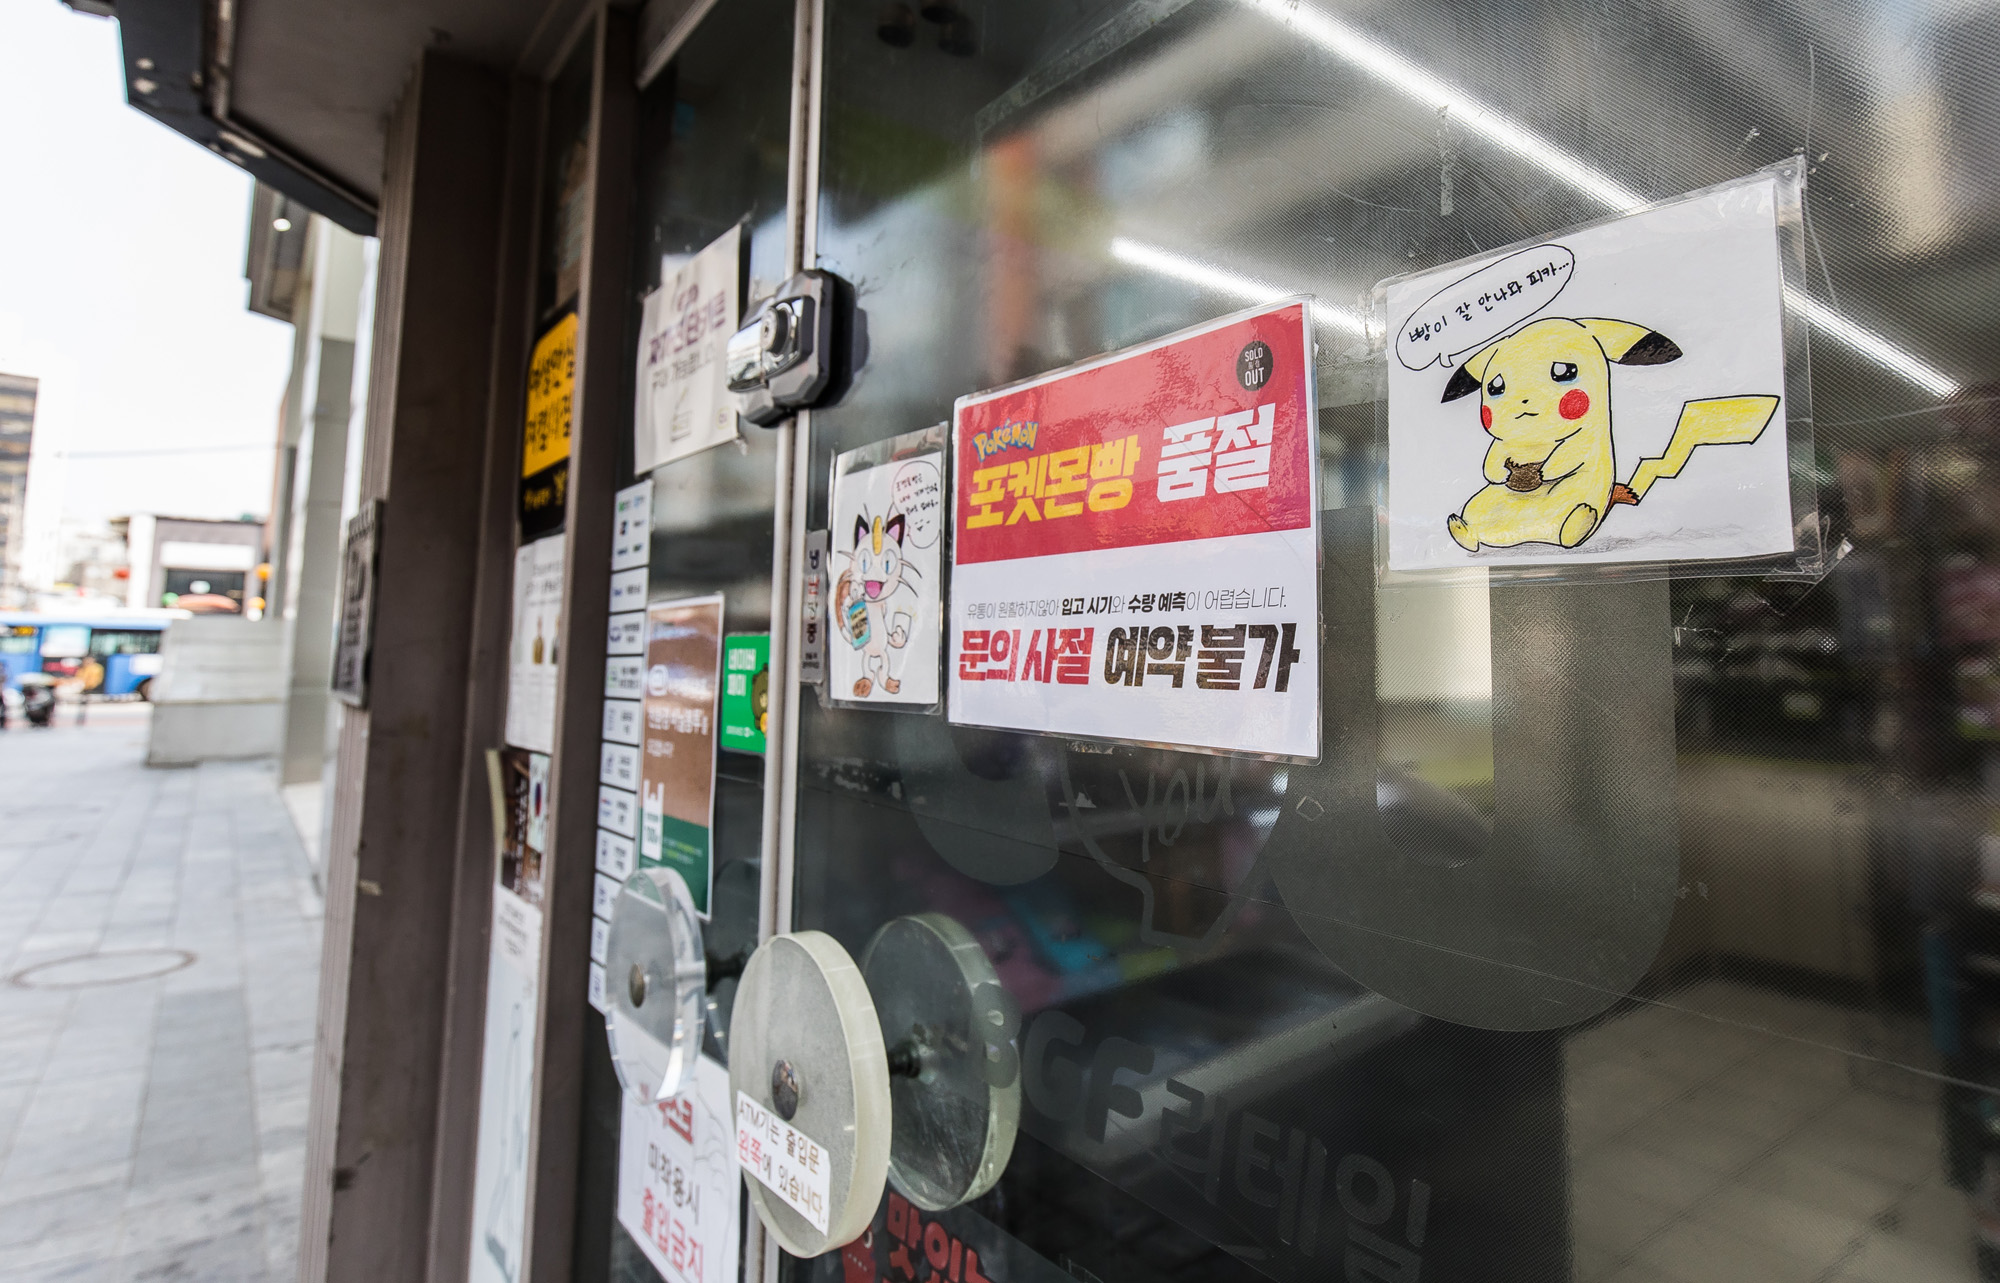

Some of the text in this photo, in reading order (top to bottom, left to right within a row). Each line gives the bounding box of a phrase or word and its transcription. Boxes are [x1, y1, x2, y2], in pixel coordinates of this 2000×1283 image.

[1408, 315, 1448, 342] 빵이
[1455, 302, 1472, 321] 잘
[1244, 347, 1263, 361] SOLD
[1244, 367, 1264, 386] OUT
[966, 402, 1276, 529] 포켓몬빵 품절
[967, 602, 995, 619] 유통이
[1062, 598, 1085, 615] 입고
[1087, 595, 1126, 614] 시기와
[1128, 594, 1156, 613] 수량
[1158, 591, 1200, 612] 예측이
[1204, 586, 1287, 610] 어렵습니다.
[958, 623, 1301, 692] 문의 사절 예약 불가
[786, 1129, 820, 1174] 출입문
[738, 1130, 826, 1223] 왼쪽에 있습니다.
[642, 1187, 703, 1283] 출입금지
